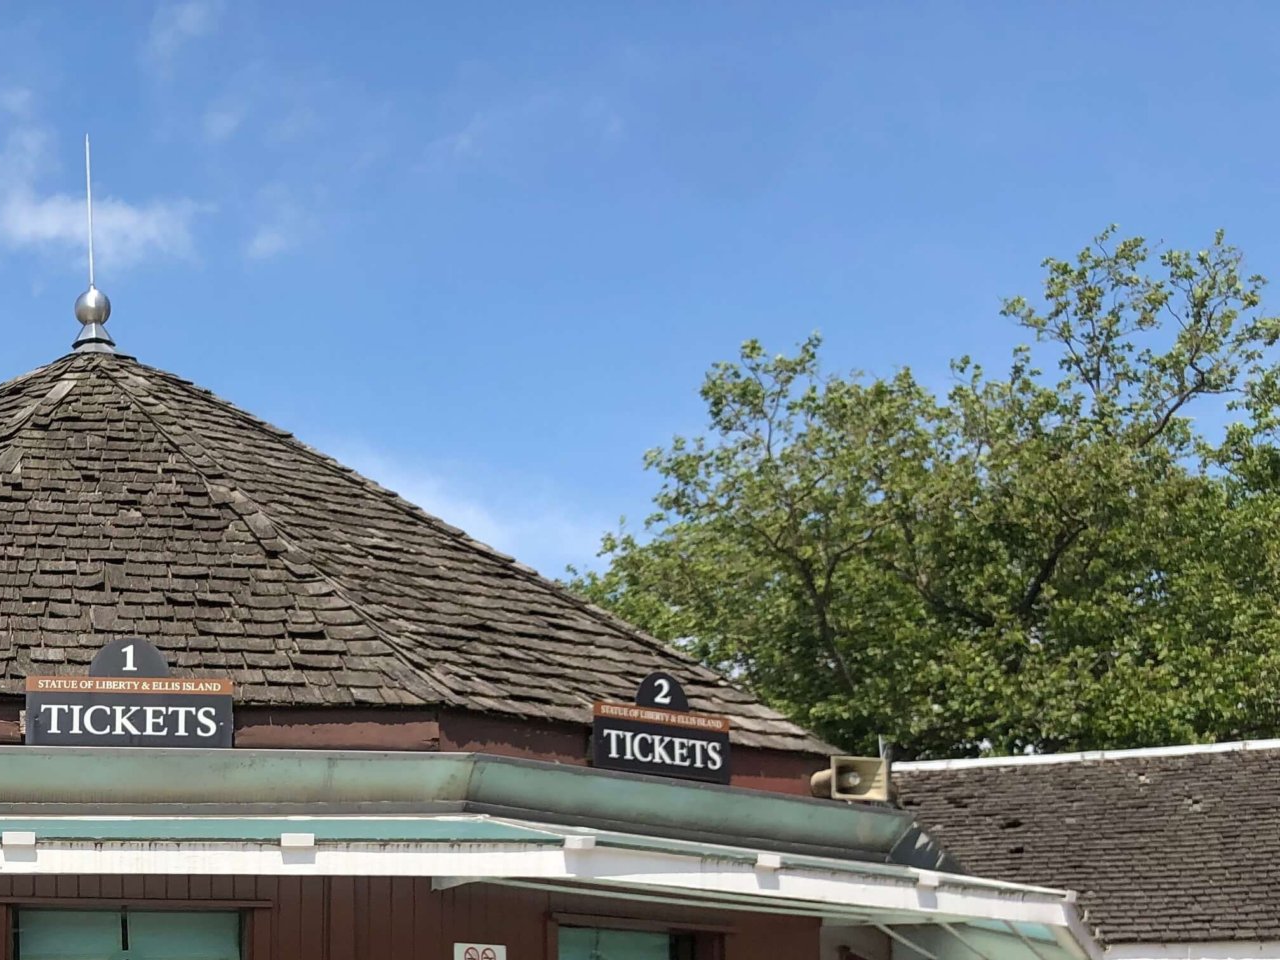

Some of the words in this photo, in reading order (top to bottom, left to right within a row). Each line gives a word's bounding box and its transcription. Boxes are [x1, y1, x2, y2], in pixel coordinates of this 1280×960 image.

[120, 644, 138, 672] 1
[38, 679, 78, 689] STATUE
[79, 680, 94, 690] OF
[95, 681, 139, 690] LIBERTY
[141, 682, 150, 690] &
[152, 682, 181, 691] ELLIS
[182, 682, 221, 692] ISLAND
[653, 678, 672, 704] 2
[40, 704, 217, 737] TICKETS
[600, 705, 629, 717] STATUE
[629, 708, 640, 718] OF
[640, 709, 669, 722] LIBERTY
[677, 714, 696, 726] ELLIS
[696, 716, 723, 728] ISLAND
[603, 729, 723, 770] TICKETS
